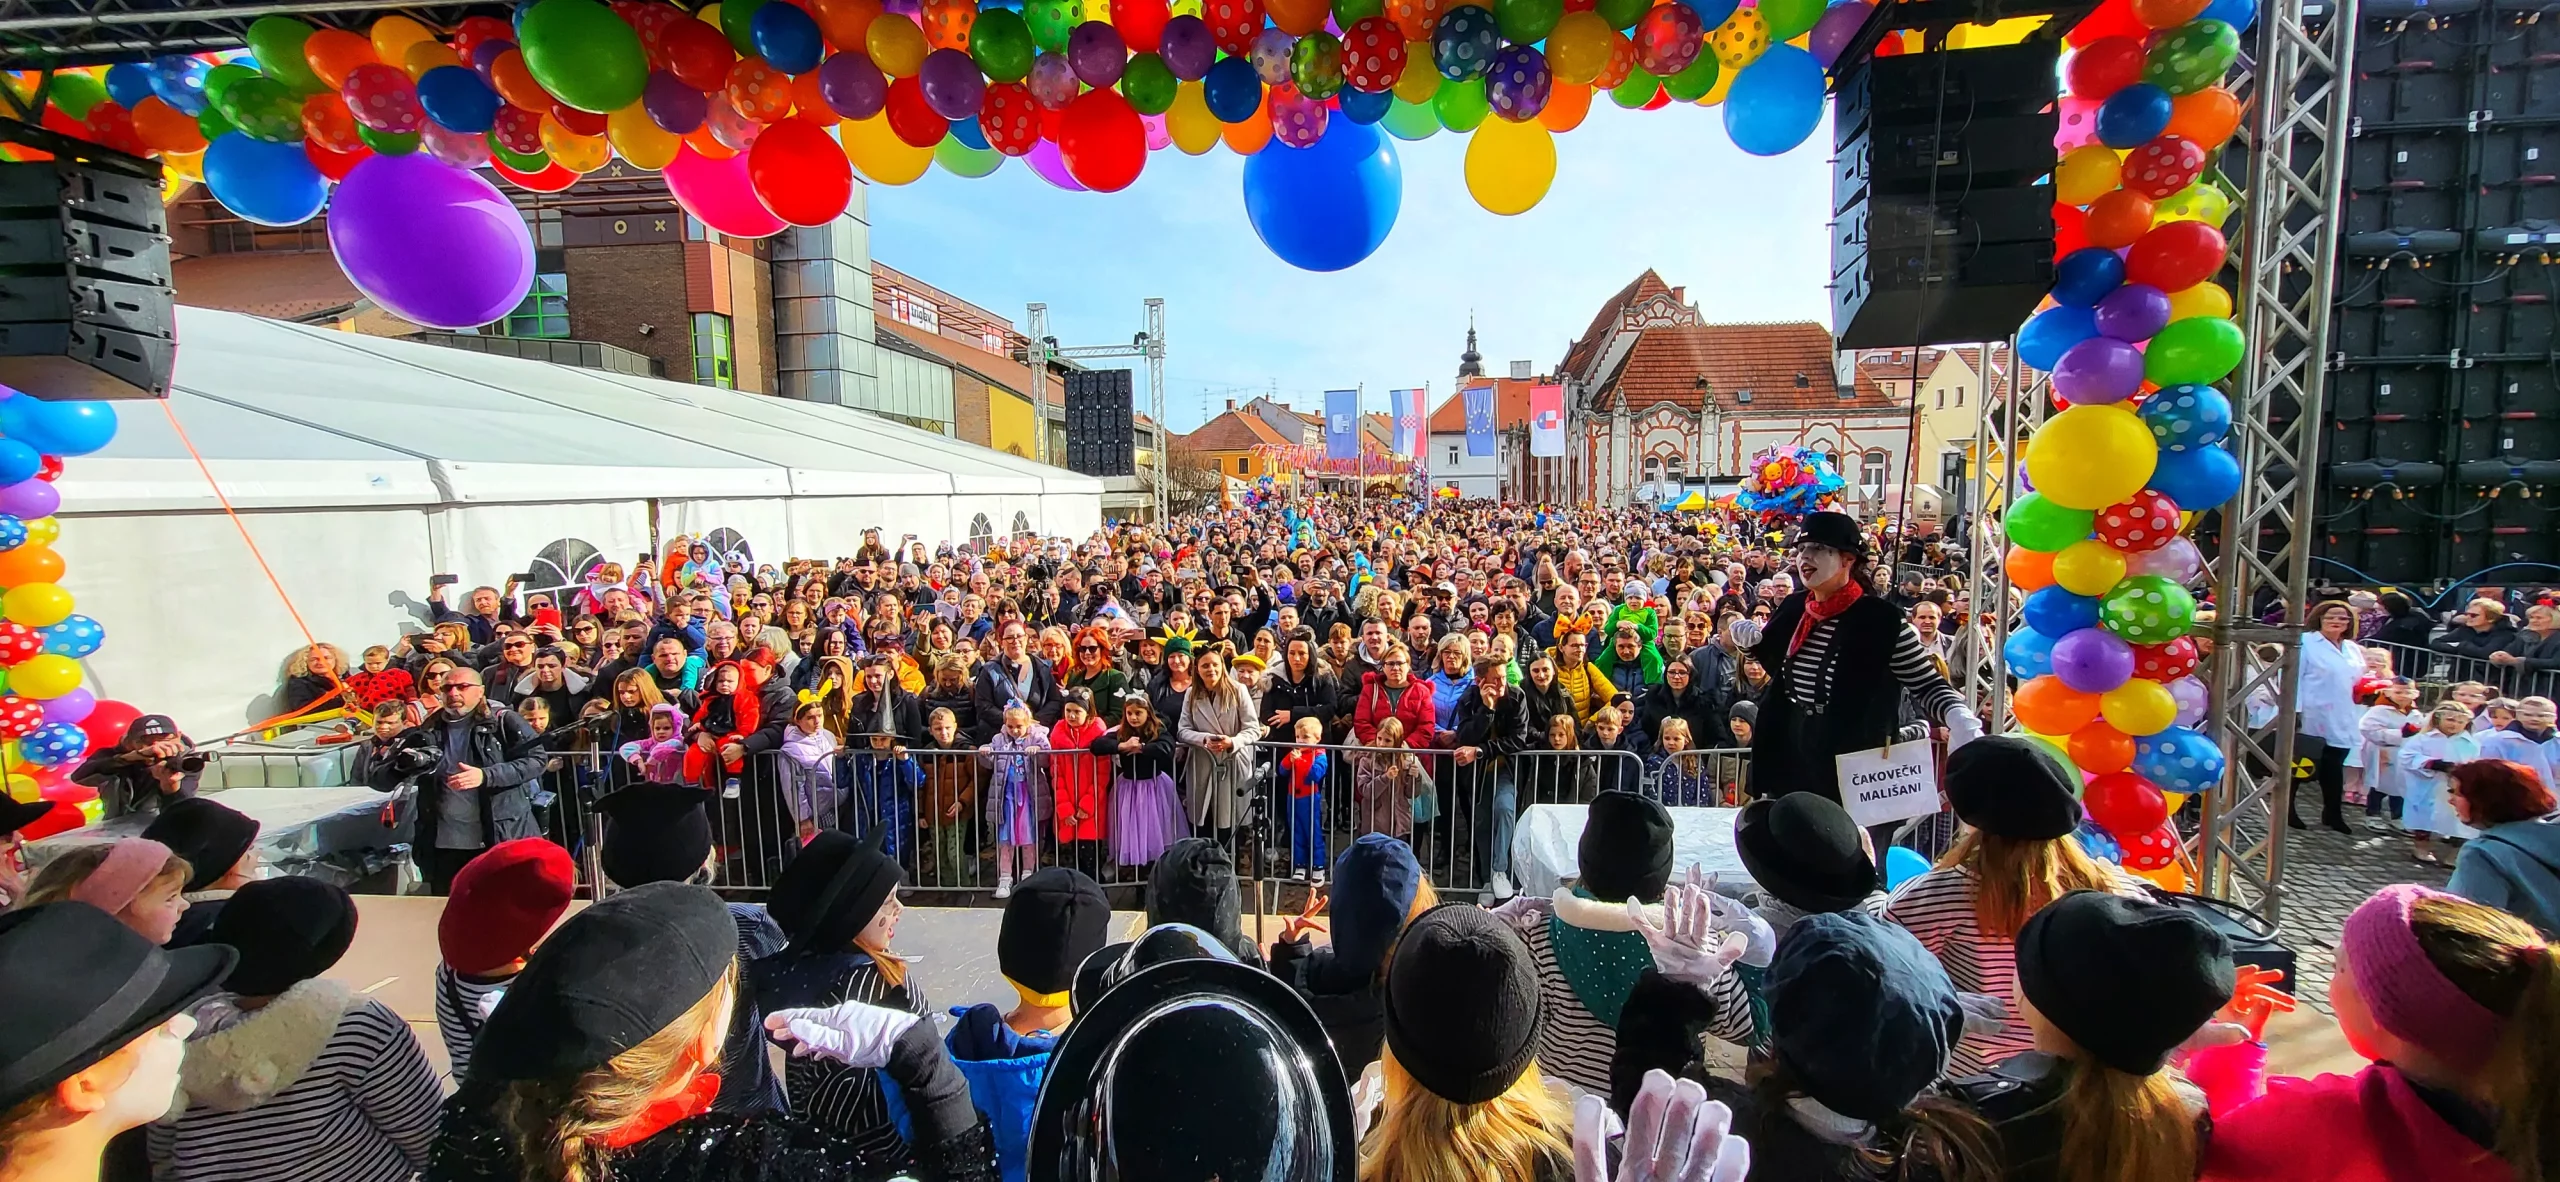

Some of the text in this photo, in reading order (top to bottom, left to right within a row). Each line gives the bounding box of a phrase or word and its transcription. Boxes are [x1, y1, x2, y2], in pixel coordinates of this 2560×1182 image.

[911, 305, 932, 324] triglav
[1852, 764, 1922, 786] ČAKOVEČKI
[1859, 782, 1921, 803] MALIŠANI
